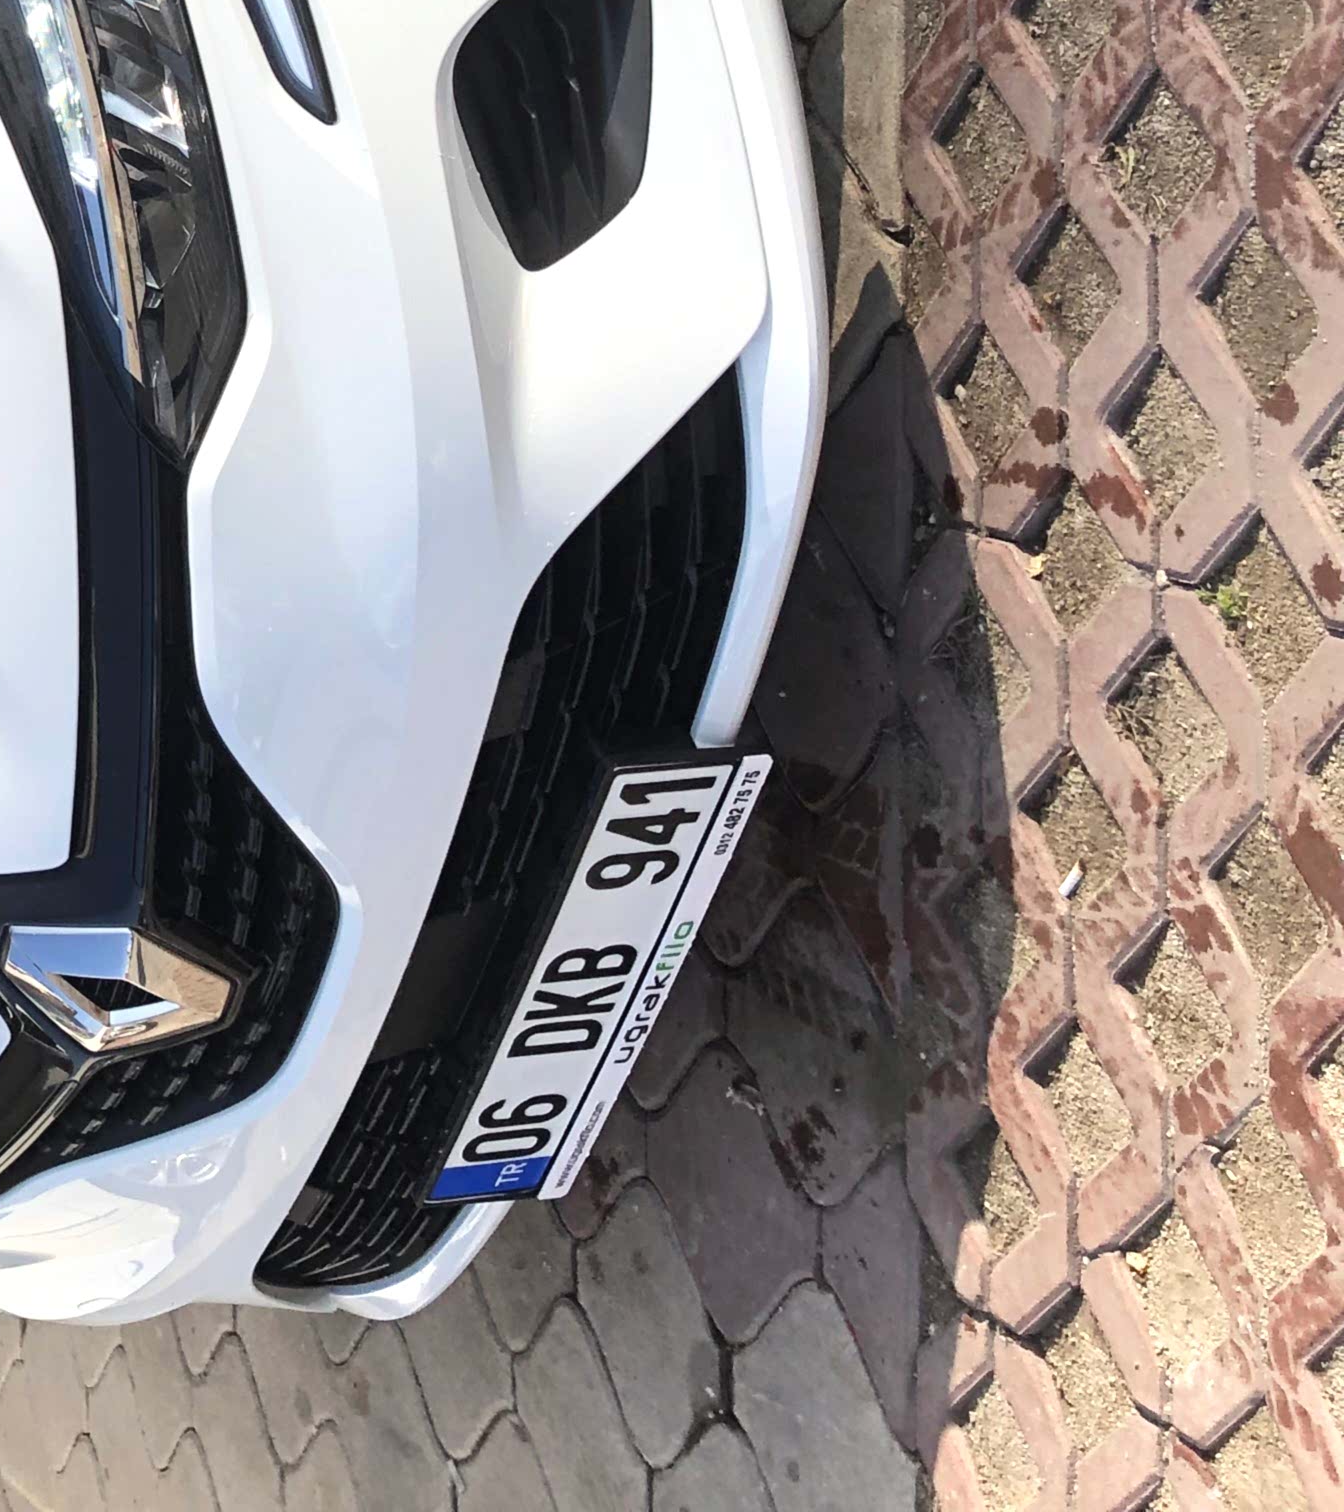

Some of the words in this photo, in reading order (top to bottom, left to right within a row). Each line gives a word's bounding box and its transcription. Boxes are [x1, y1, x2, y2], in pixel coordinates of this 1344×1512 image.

[742, 770, 761, 787] 75
[733, 789, 753, 805] 75
[723, 807, 746, 830] 482
[584, 775, 717, 891] 941
[713, 832, 734, 856] 0312
[506, 944, 639, 1058] DKB
[461, 1093, 568, 1163] 06
[494, 1162, 528, 1187] TR
